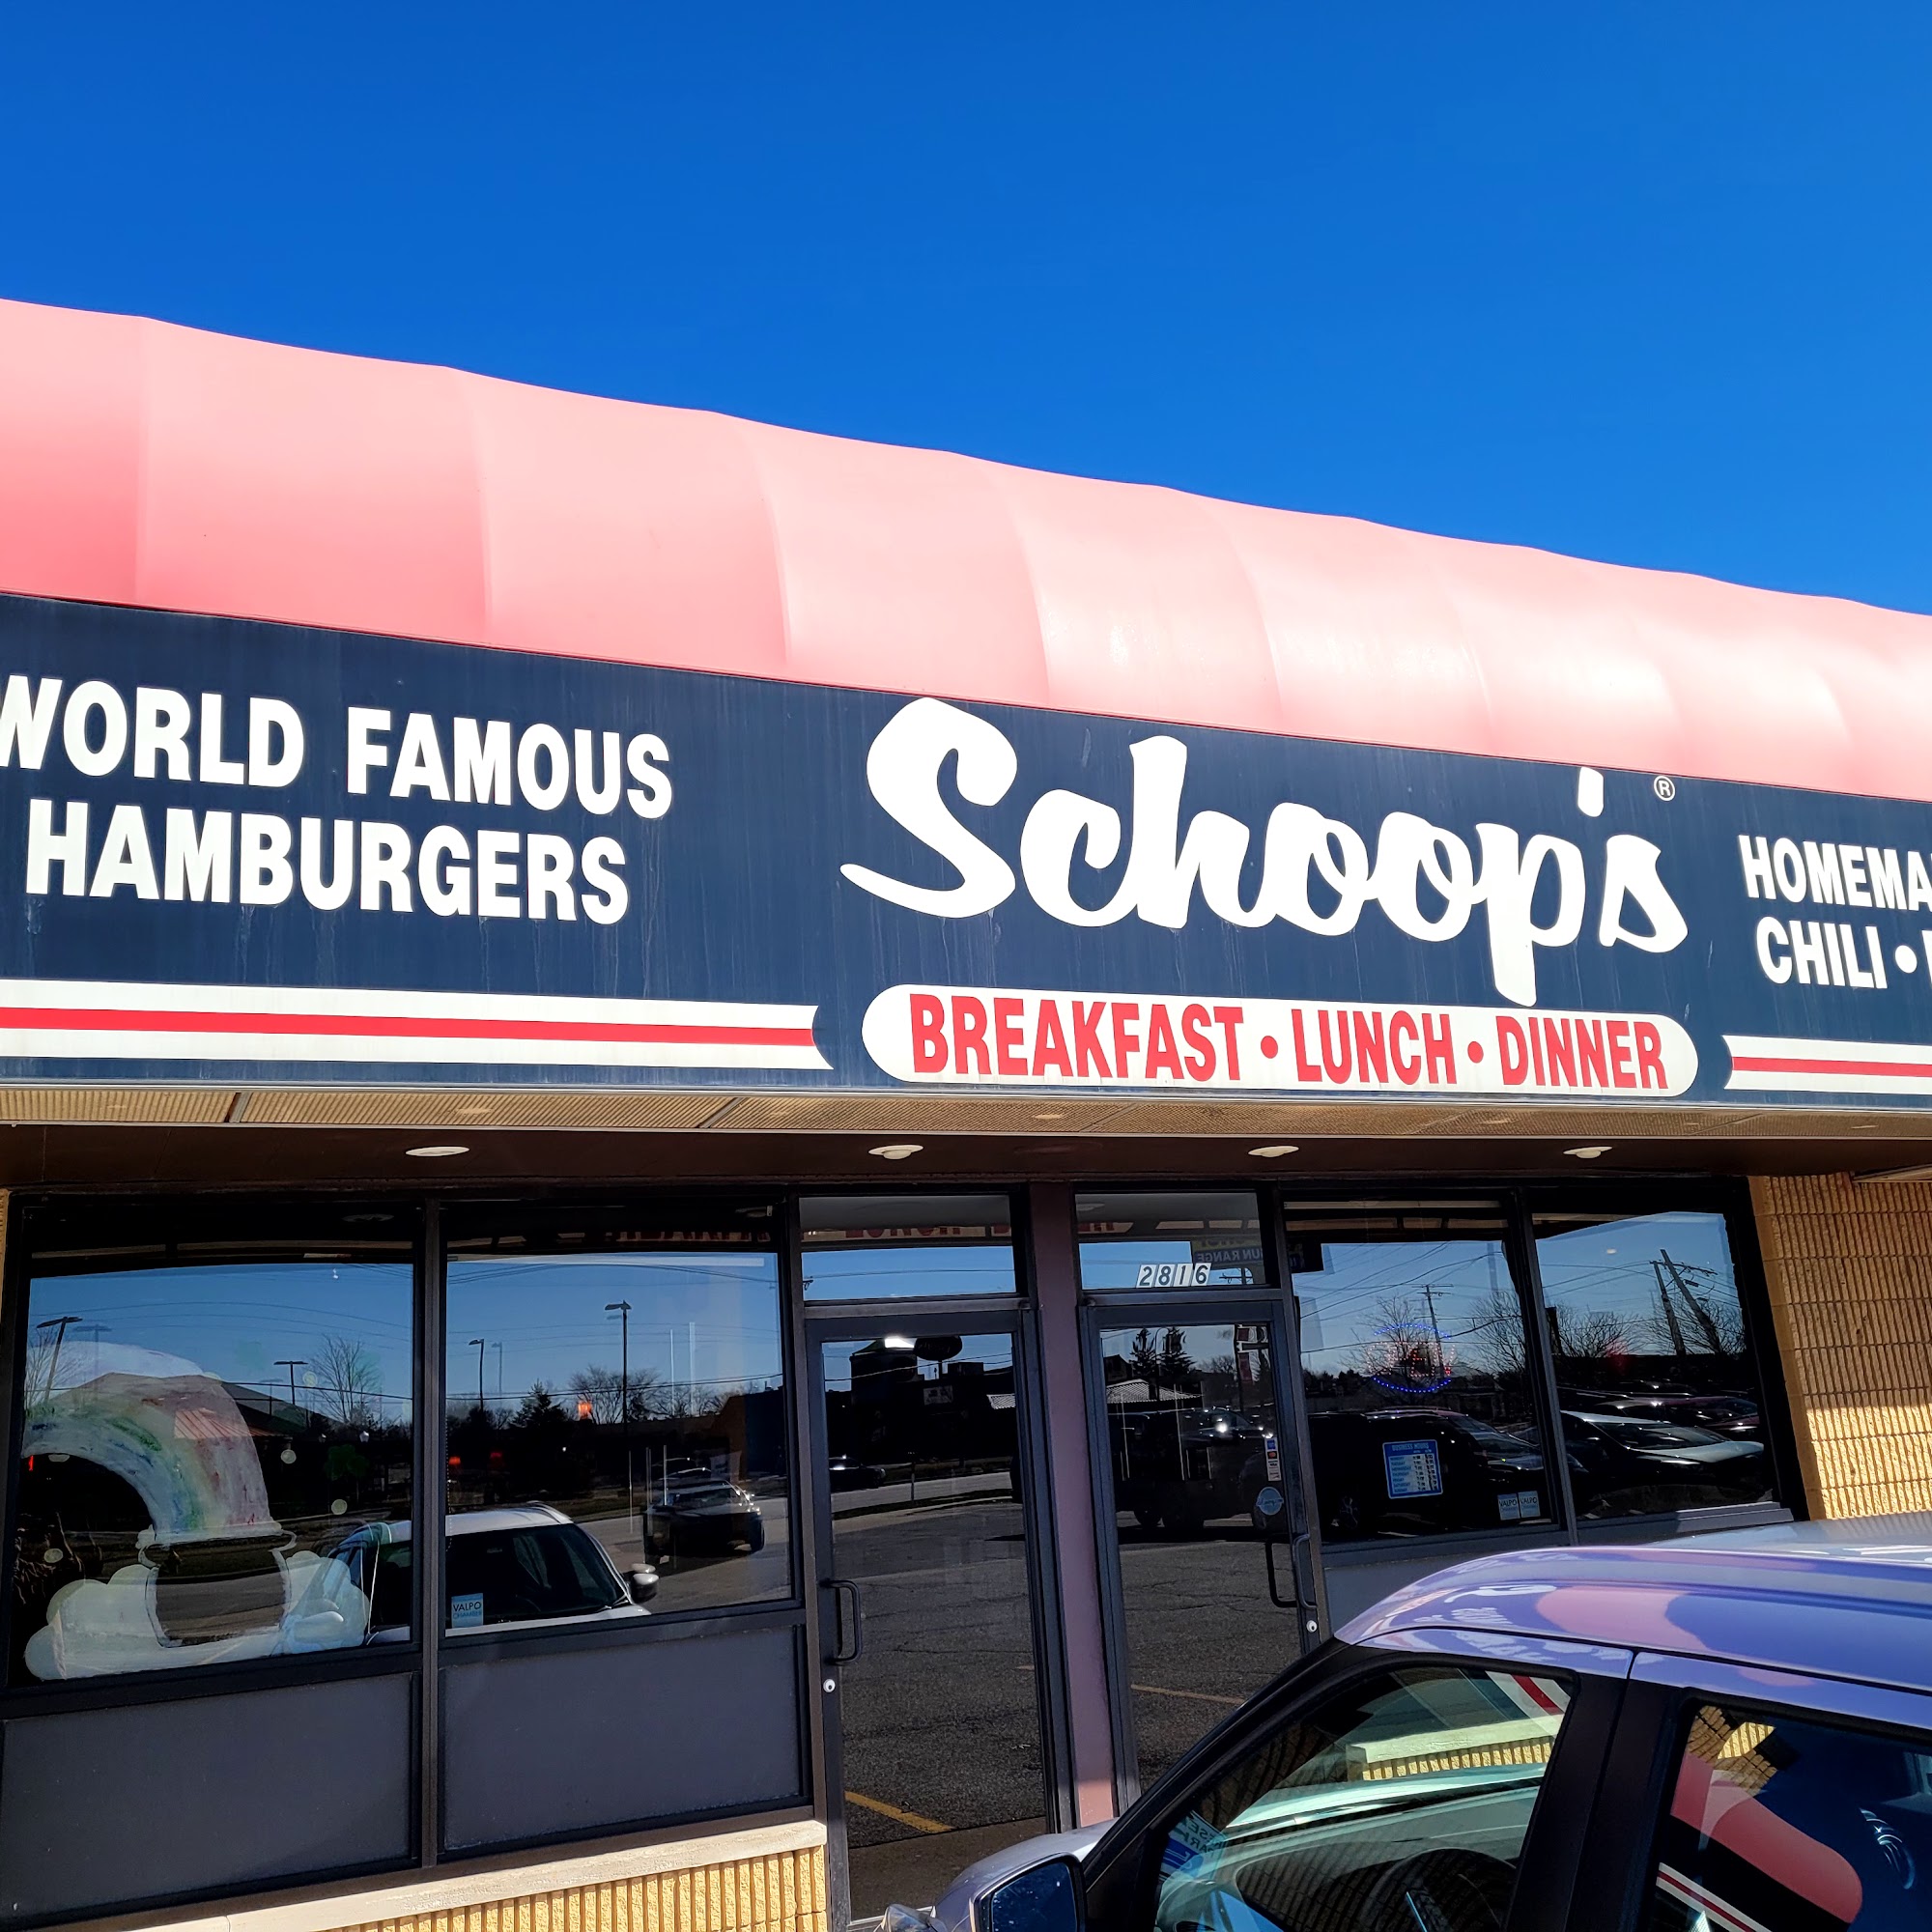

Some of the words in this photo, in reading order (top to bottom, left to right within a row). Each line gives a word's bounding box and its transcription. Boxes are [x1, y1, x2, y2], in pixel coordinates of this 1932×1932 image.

[0, 675, 303, 786] WORLD
[348, 707, 671, 818] FAMOUS
[27, 799, 628, 923] HAMBURGERS
[840, 697, 1688, 1007] Schoop's
[1739, 836, 1932, 912] HOMEMA
[1757, 917, 1887, 988] CHILI
[910, 994, 1243, 1081] BREAKFAST
[1292, 1010, 1456, 1085] LUNCH
[1496, 1016, 1666, 1089] DINNER
[1139, 1264, 1208, 1286] 2816
[1499, 1498, 1518, 1507] VALPO
[453, 1602, 481, 1611] VALPO
